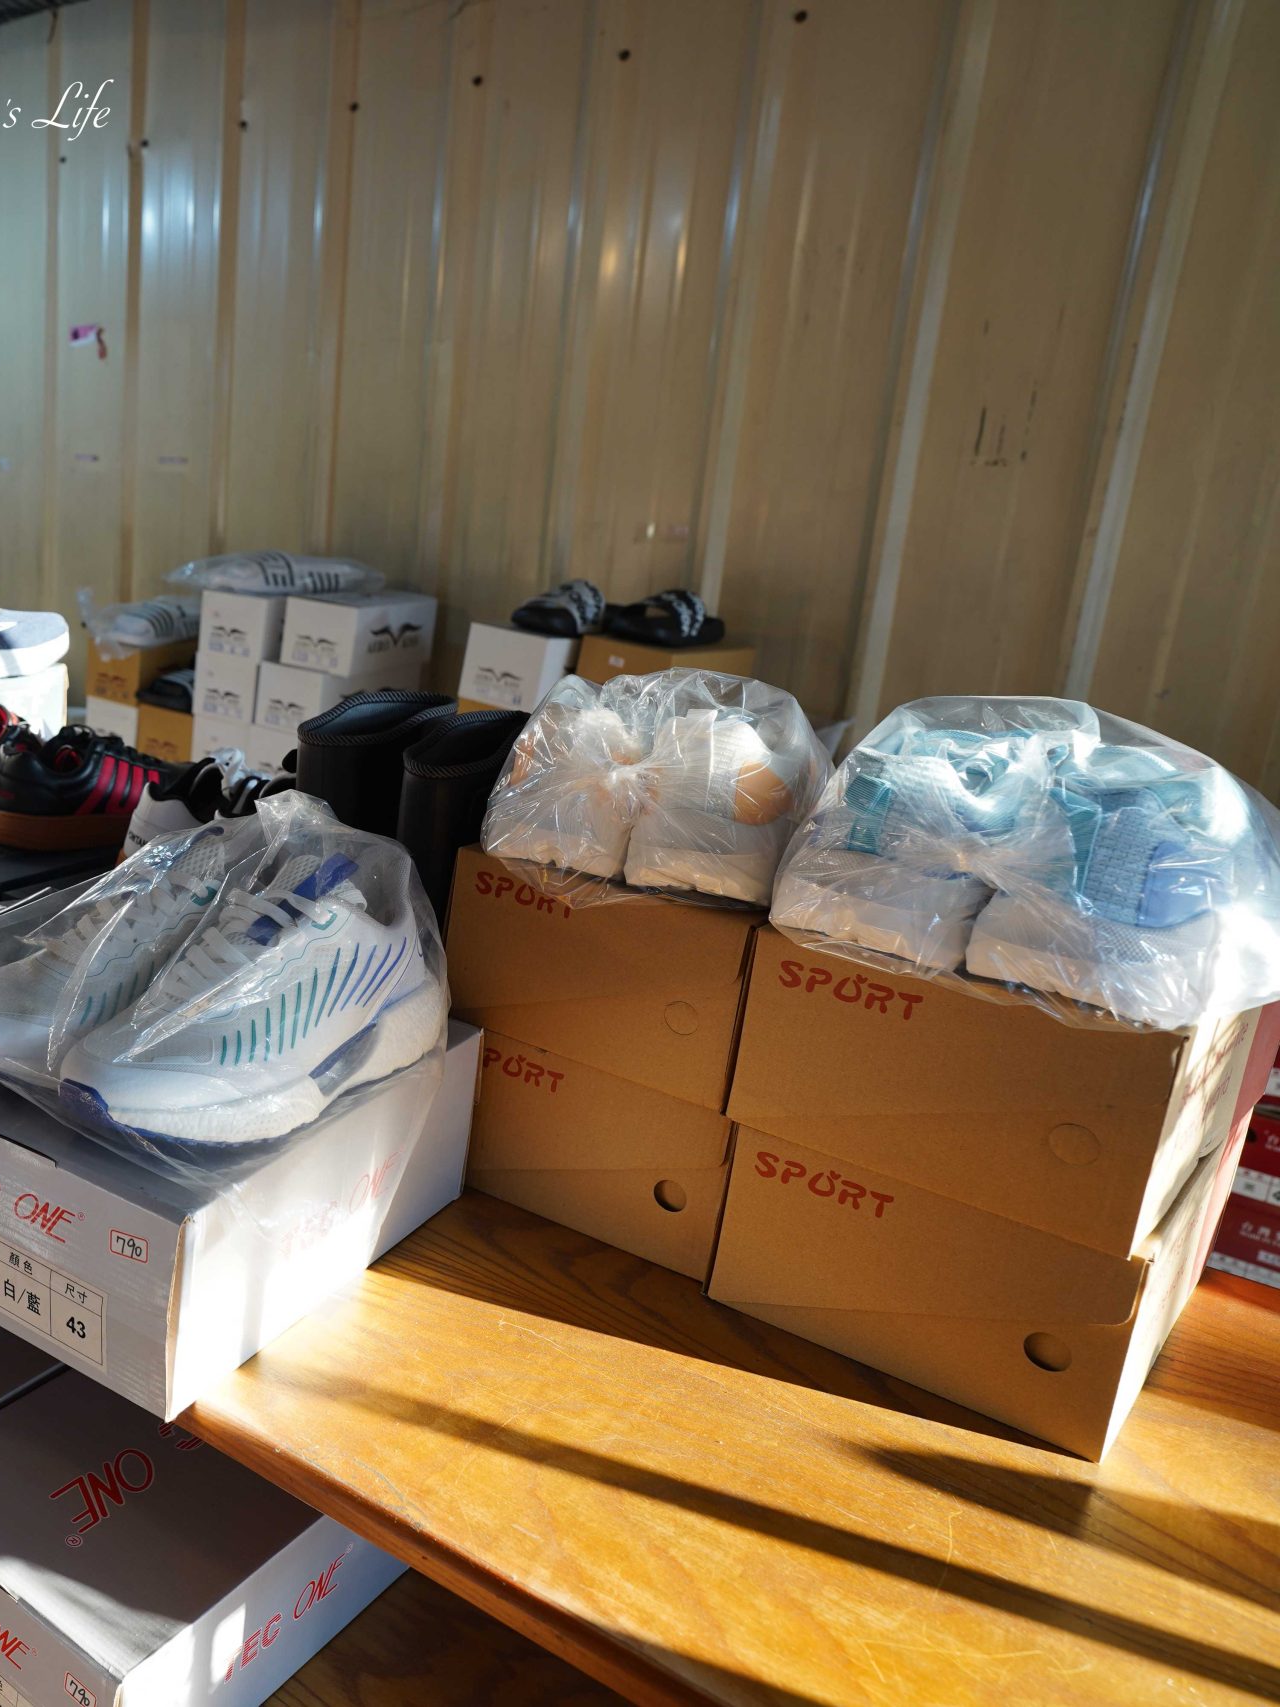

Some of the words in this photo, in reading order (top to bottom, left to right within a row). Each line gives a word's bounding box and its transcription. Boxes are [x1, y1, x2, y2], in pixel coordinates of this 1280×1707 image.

[778, 960, 924, 1021] SPORT
[482, 1047, 565, 1093] PORT
[754, 1151, 895, 1219] SPORT
[14, 1193, 76, 1243] ONE
[3, 1278, 41, 1316] 白/藍
[66, 1315, 87, 1339] 43
[64, 1282, 89, 1305] 尺寸
[49, 1448, 155, 1535] ONE
[293, 1552, 346, 1621] ONE
